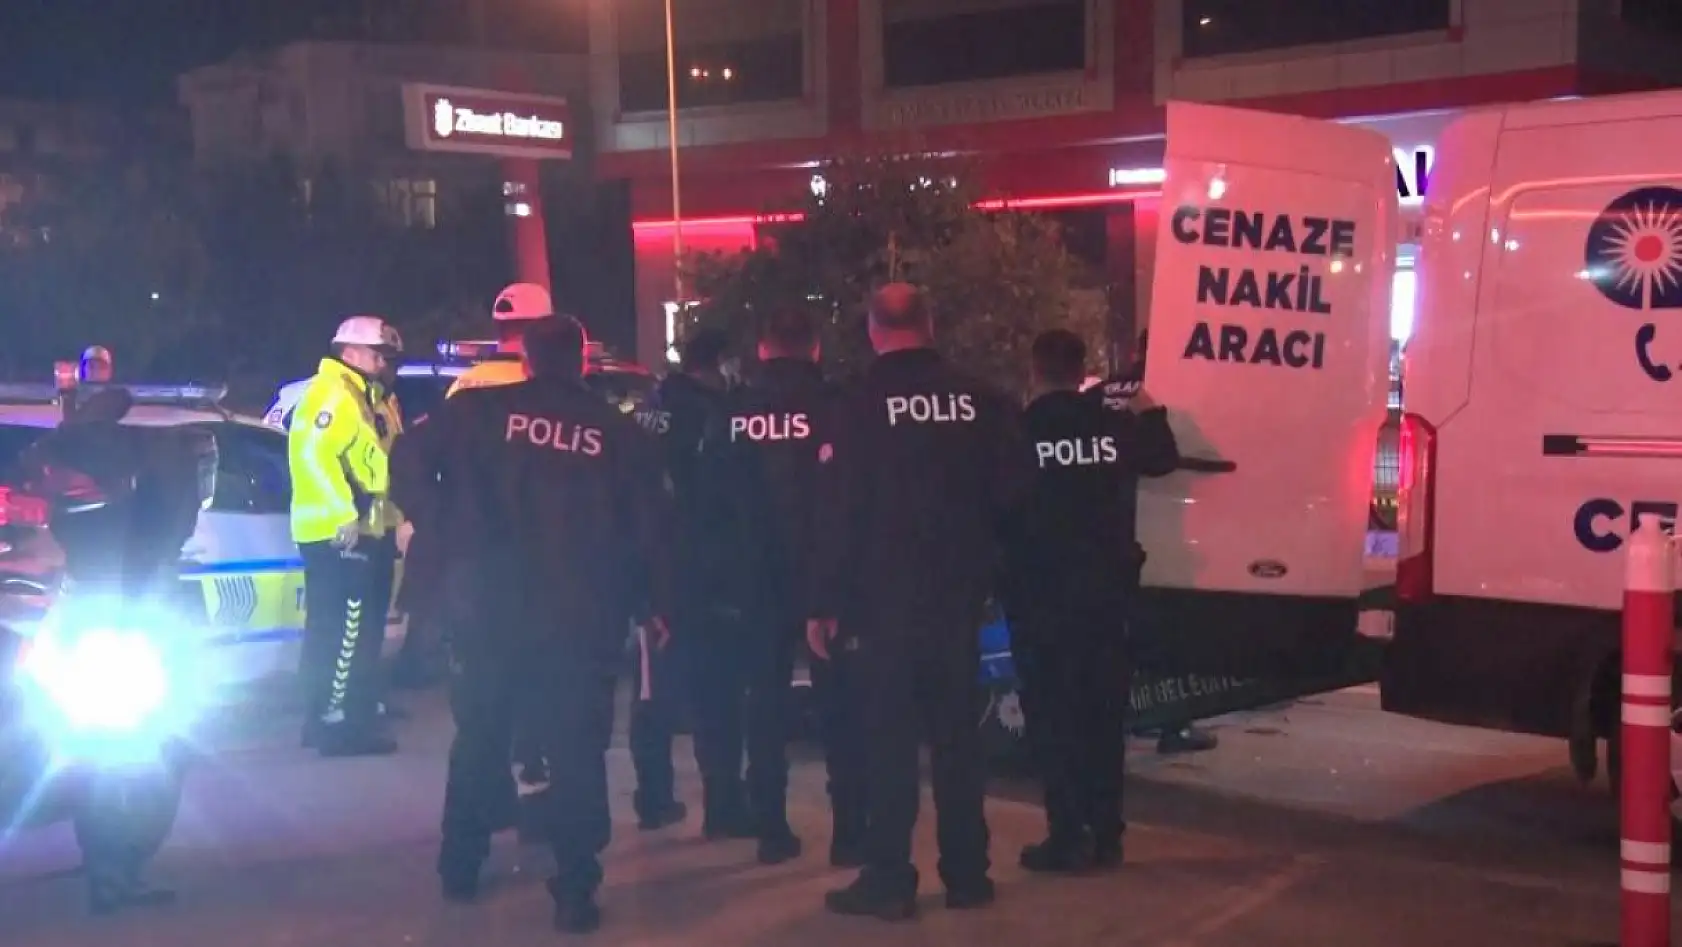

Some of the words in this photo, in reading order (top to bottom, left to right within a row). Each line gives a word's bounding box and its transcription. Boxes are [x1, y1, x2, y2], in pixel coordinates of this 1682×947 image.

[1171, 205, 1356, 257] CENAZE
[1196, 265, 1331, 314] NAKİL
[1183, 322, 1325, 369] ARACI
